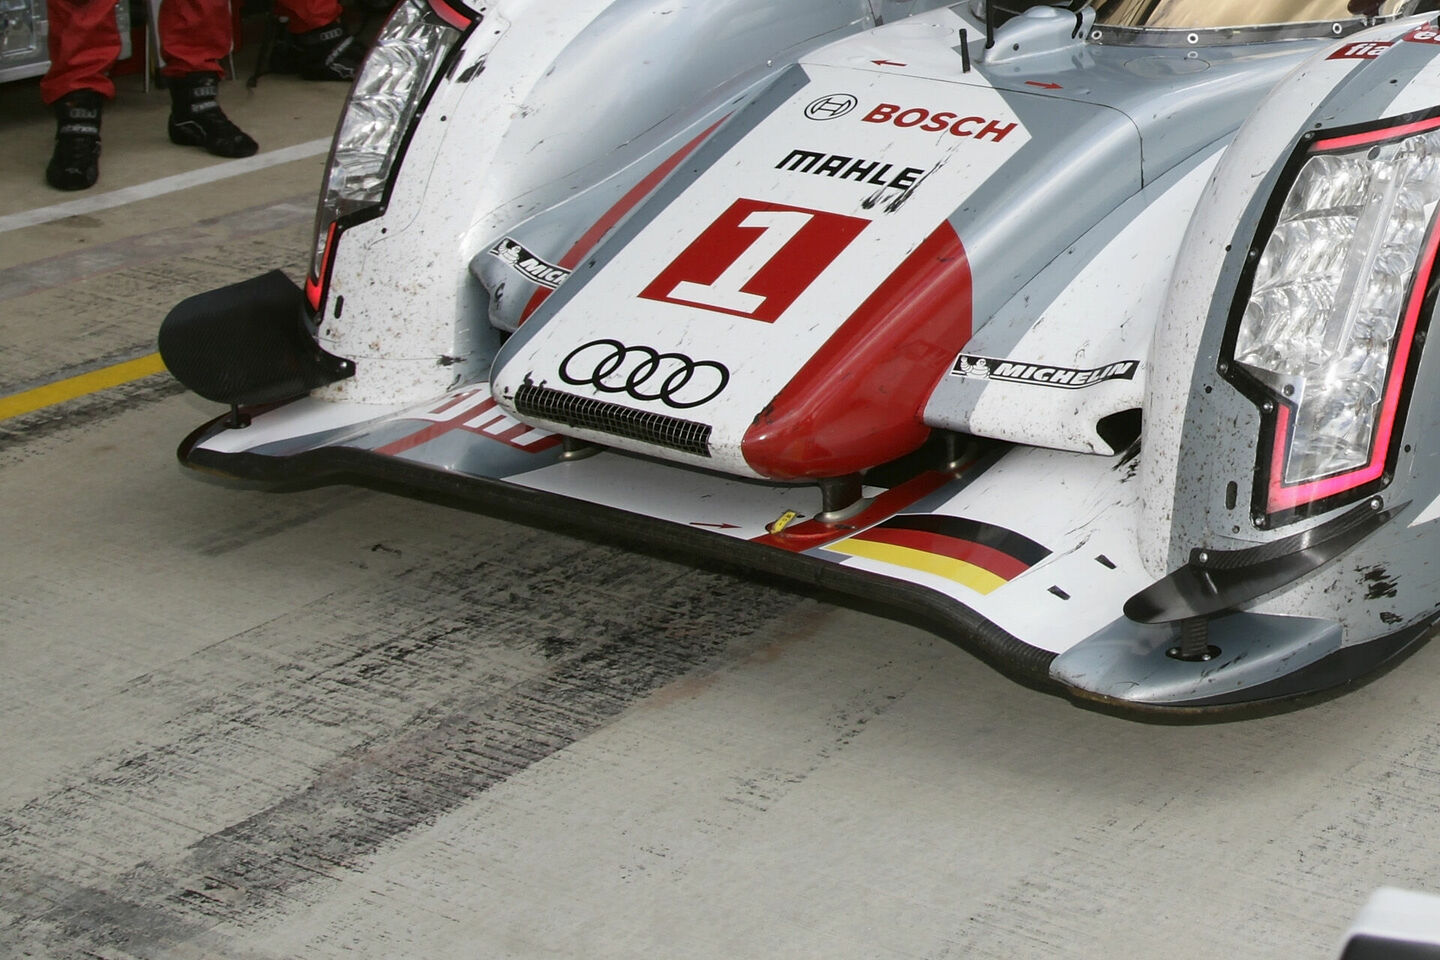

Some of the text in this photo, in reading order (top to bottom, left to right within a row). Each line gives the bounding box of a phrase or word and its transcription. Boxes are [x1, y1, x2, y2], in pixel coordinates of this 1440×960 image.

[861, 103, 1018, 143] BOSCH
[774, 149, 925, 191] MAHLE
[666, 210, 815, 315] 1
[999, 361, 1134, 385] MICHELIN
